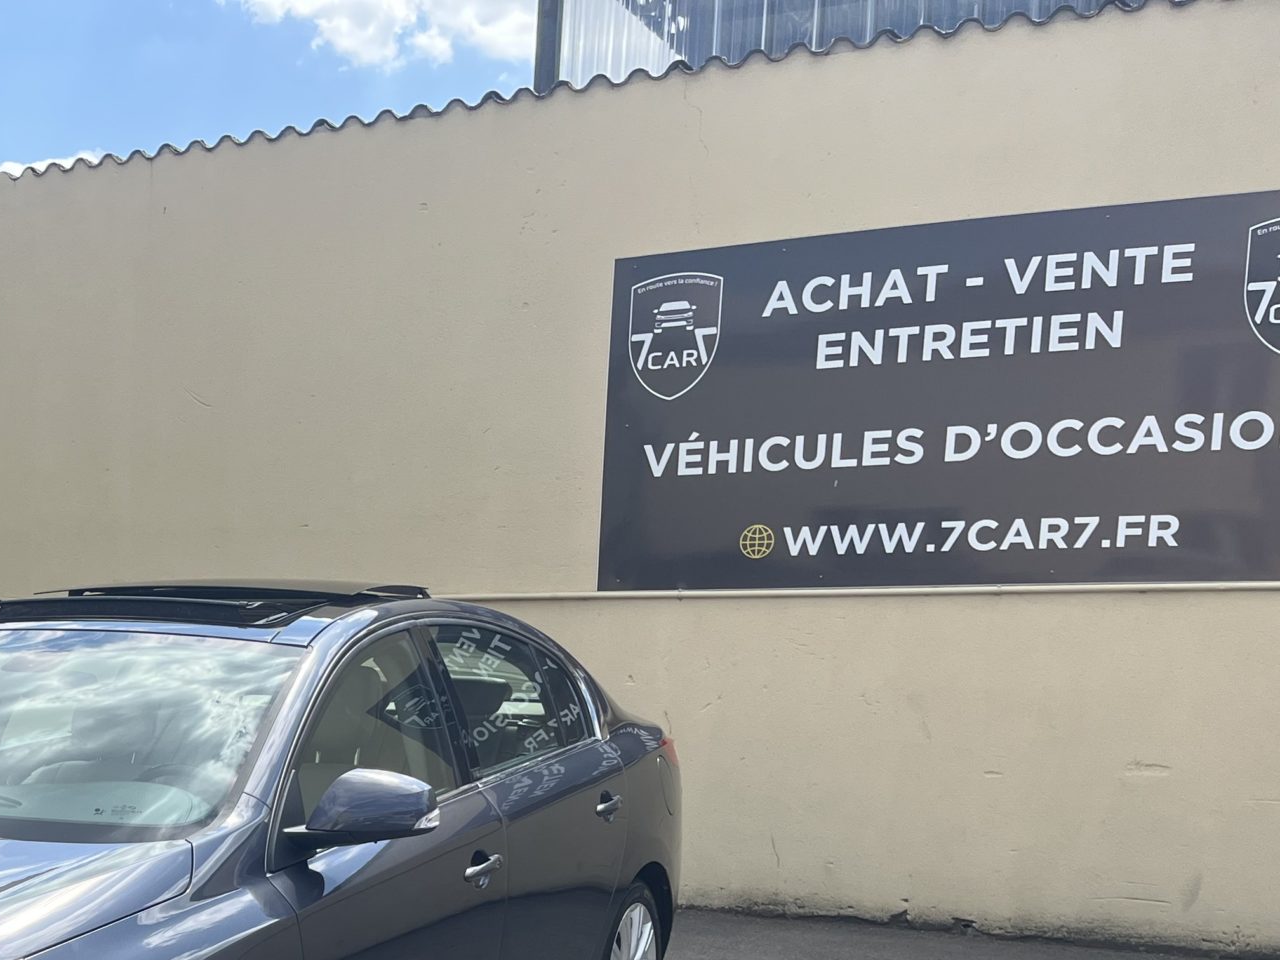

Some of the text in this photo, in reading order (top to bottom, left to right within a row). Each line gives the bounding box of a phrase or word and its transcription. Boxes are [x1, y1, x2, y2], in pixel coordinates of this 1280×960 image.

[646, 281, 663, 291] route
[664, 279, 677, 287] vers
[761, 265, 949, 318] ACHAT
[1004, 243, 1196, 295] VENTE
[816, 310, 1124, 370] ENTRETIEN
[643, 428, 924, 477] VÉHICULES
[783, 514, 1180, 556] WWW.7CAR7.FR
